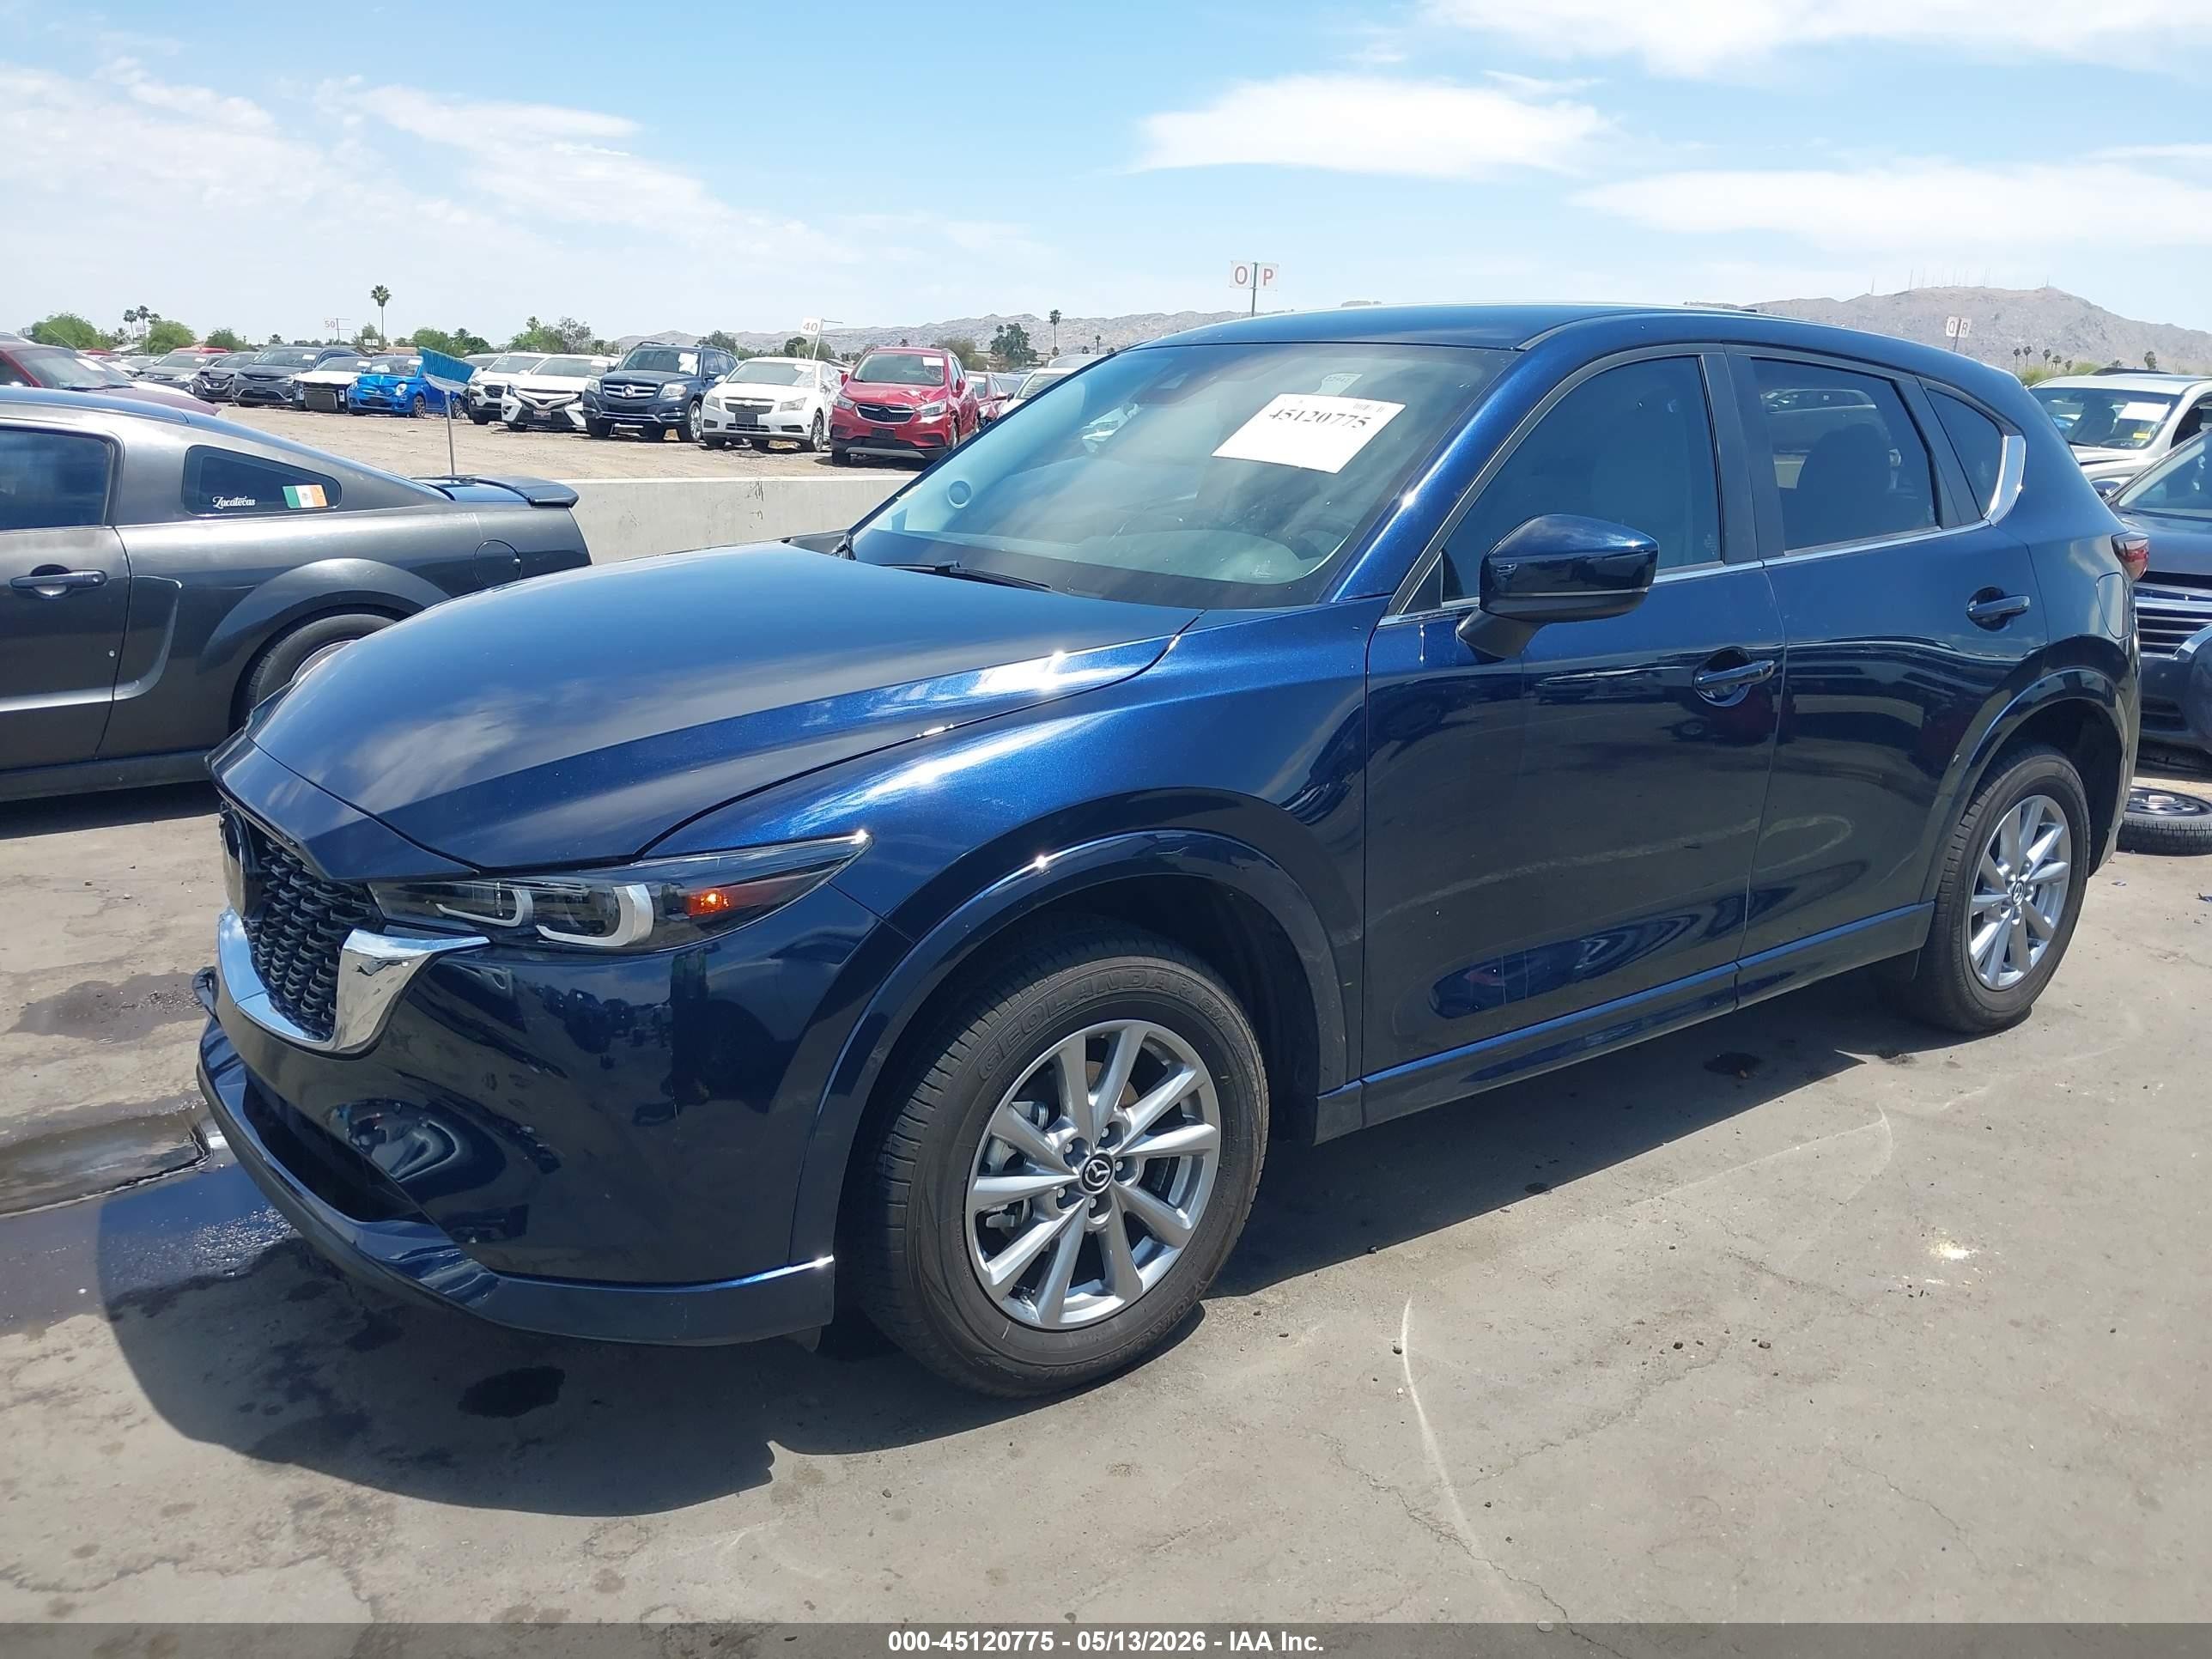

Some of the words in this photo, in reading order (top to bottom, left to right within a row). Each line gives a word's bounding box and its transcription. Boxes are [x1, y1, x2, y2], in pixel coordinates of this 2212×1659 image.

[1234, 265, 1249, 285] O
[1263, 267, 1274, 286] P
[803, 322, 818, 331] 40
[1960, 322, 1968, 335] R
[1268, 408, 1372, 428] 45120775
[212, 495, 256, 509] Zacatecas
[975, 967, 1197, 1081] GEOLANDAR
